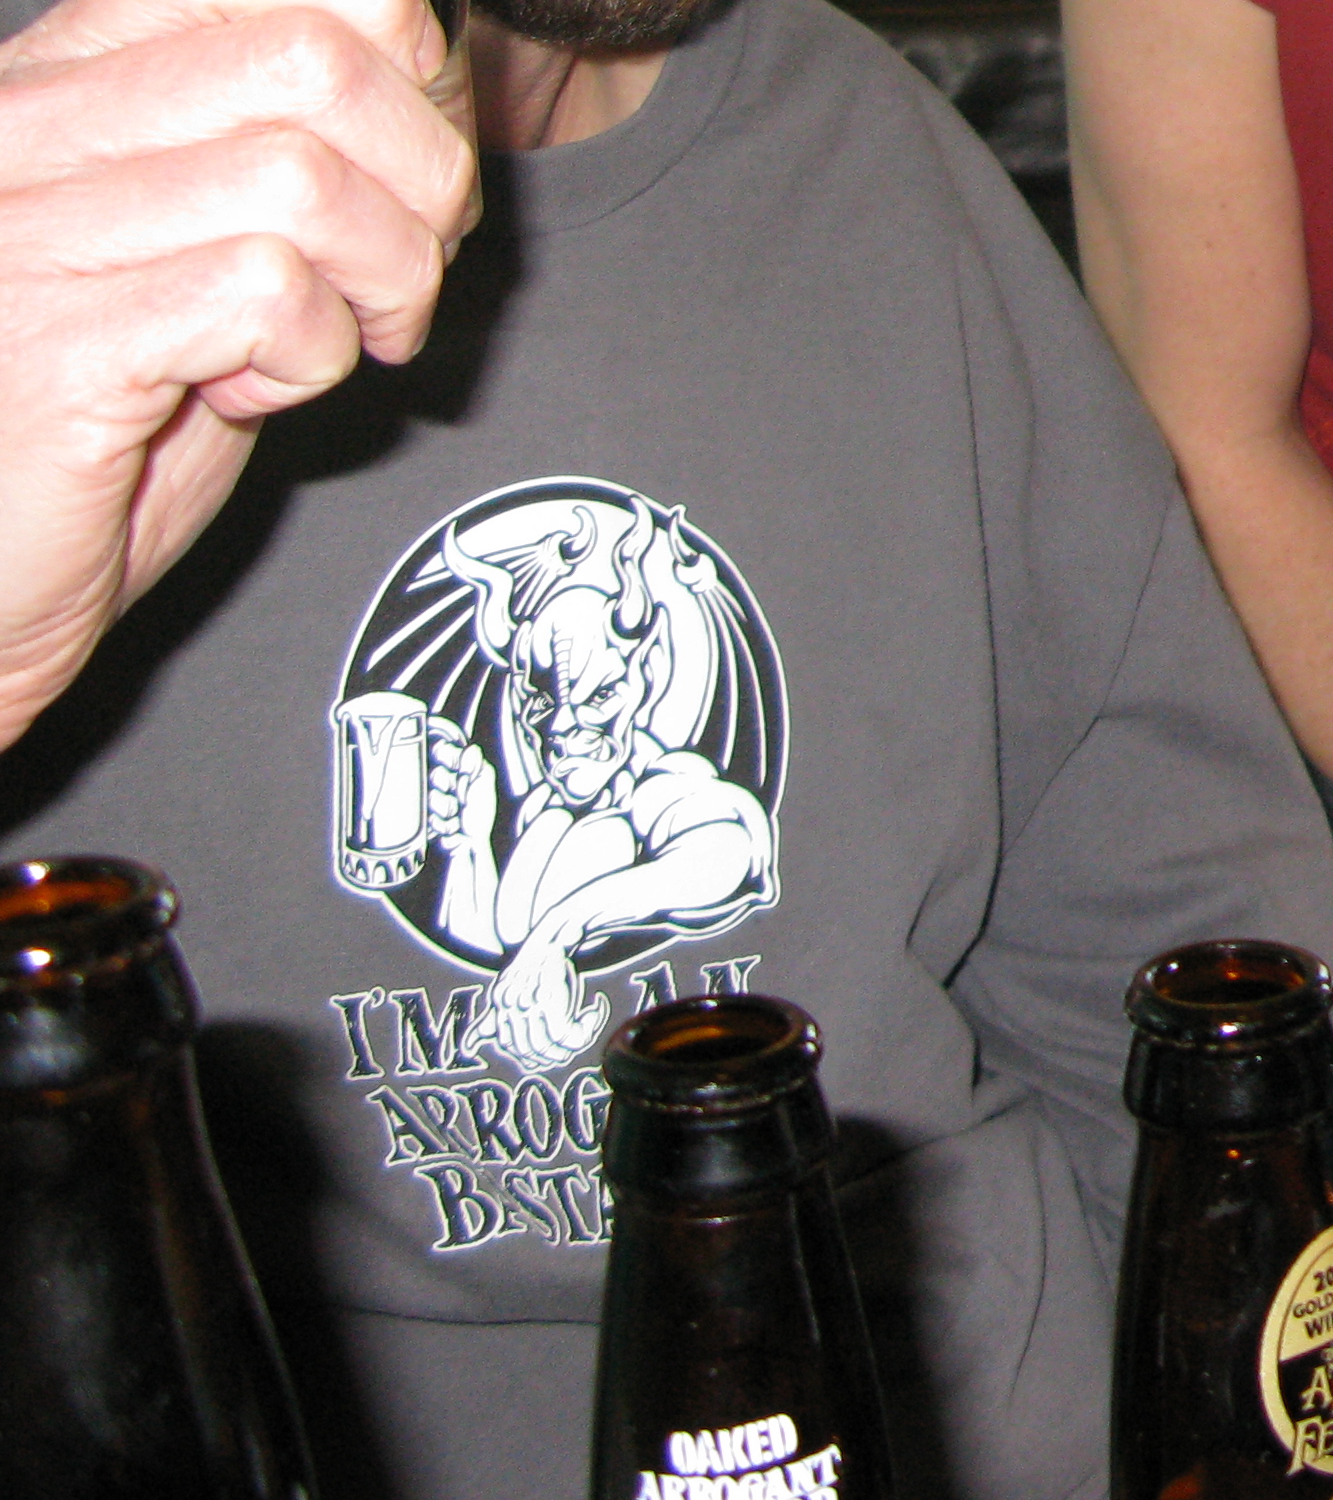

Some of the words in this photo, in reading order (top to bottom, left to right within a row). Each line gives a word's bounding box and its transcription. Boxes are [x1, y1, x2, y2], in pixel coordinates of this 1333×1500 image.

[330, 986, 484, 1081] I'M
[366, 1067, 610, 1166] ARROG
[1293, 1292, 1333, 1318] GOLD
[668, 1414, 797, 1475] OAKED
